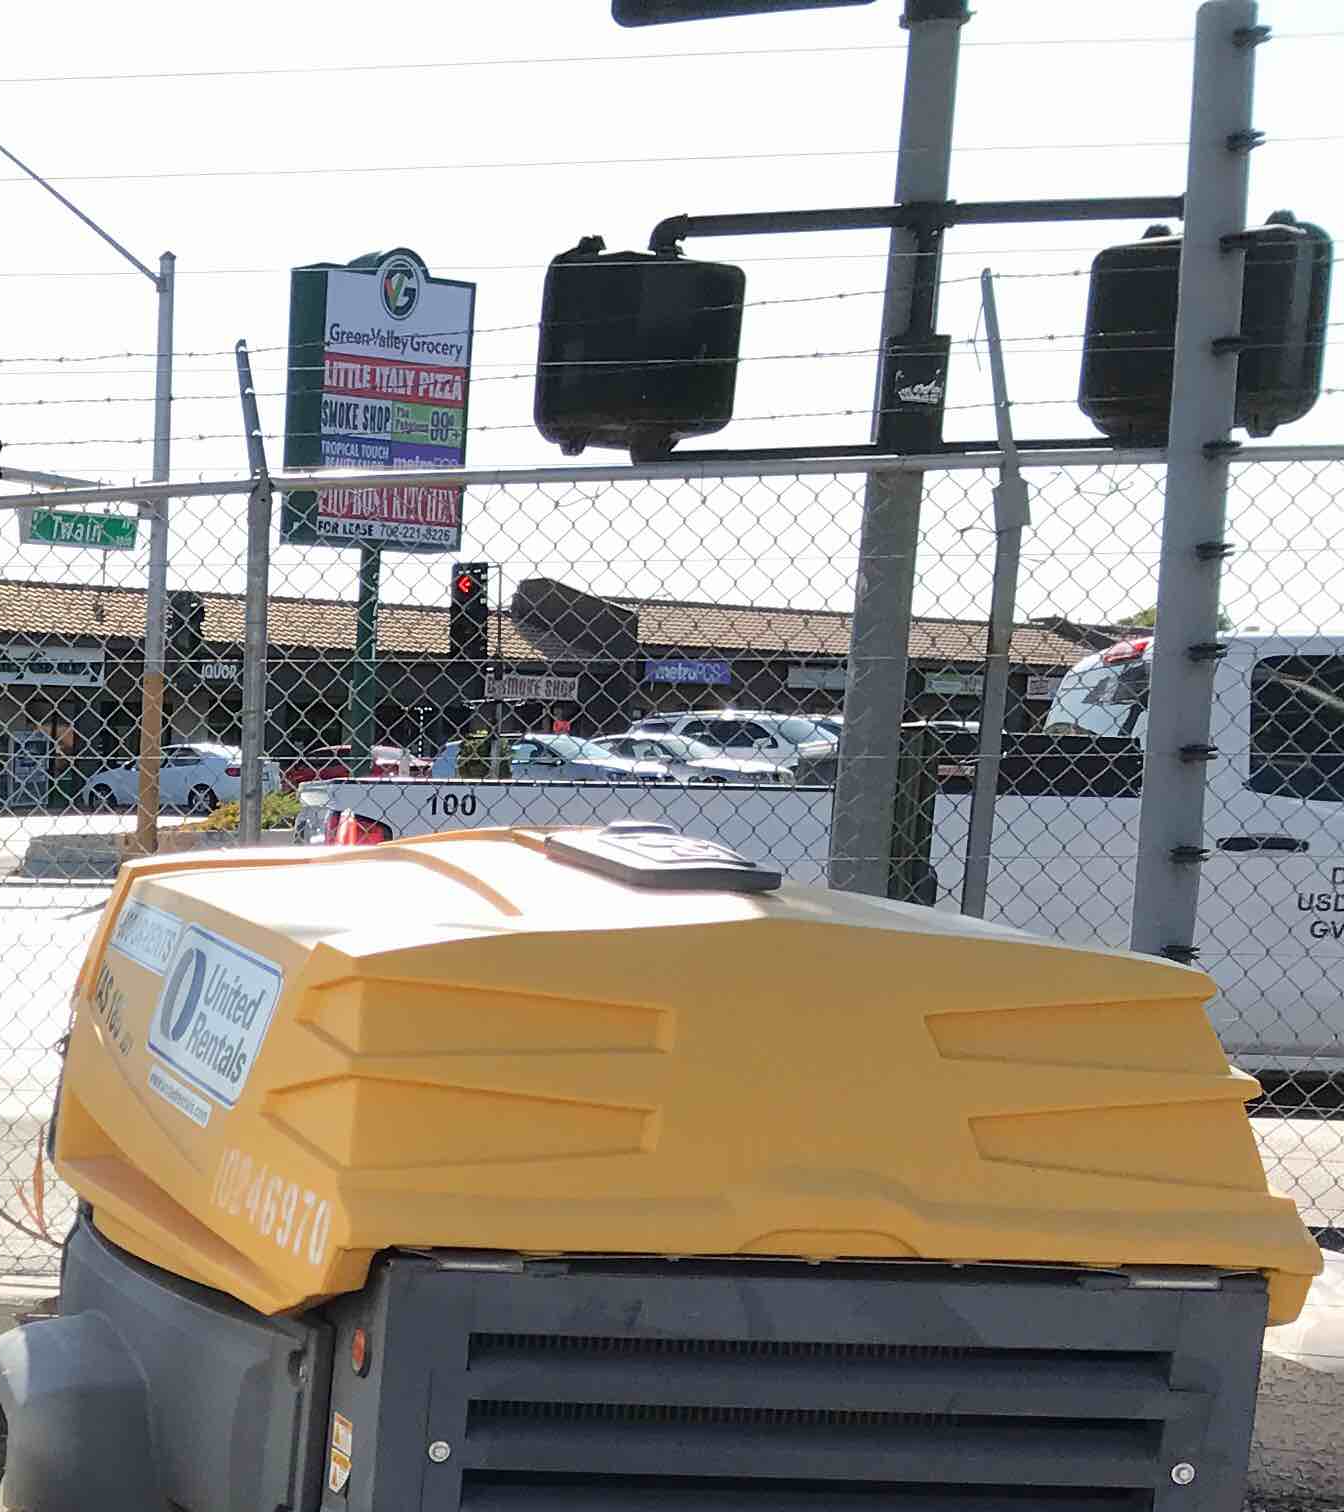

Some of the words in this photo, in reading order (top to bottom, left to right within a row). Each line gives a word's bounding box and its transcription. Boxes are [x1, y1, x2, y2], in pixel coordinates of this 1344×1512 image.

[329, 323, 370, 345] Green
[369, 328, 411, 355] Valley
[411, 336, 464, 362] Grocery
[324, 360, 371, 389] LITTLE
[321, 399, 360, 430] SMOKE
[363, 404, 392, 433] SHOP
[52, 515, 103, 543] Twain
[318, 519, 340, 536] FOR
[343, 522, 375, 538] LEASE
[428, 792, 478, 817] 100
[202, 963, 267, 1032] United
[184, 1013, 247, 1086] Rentals
